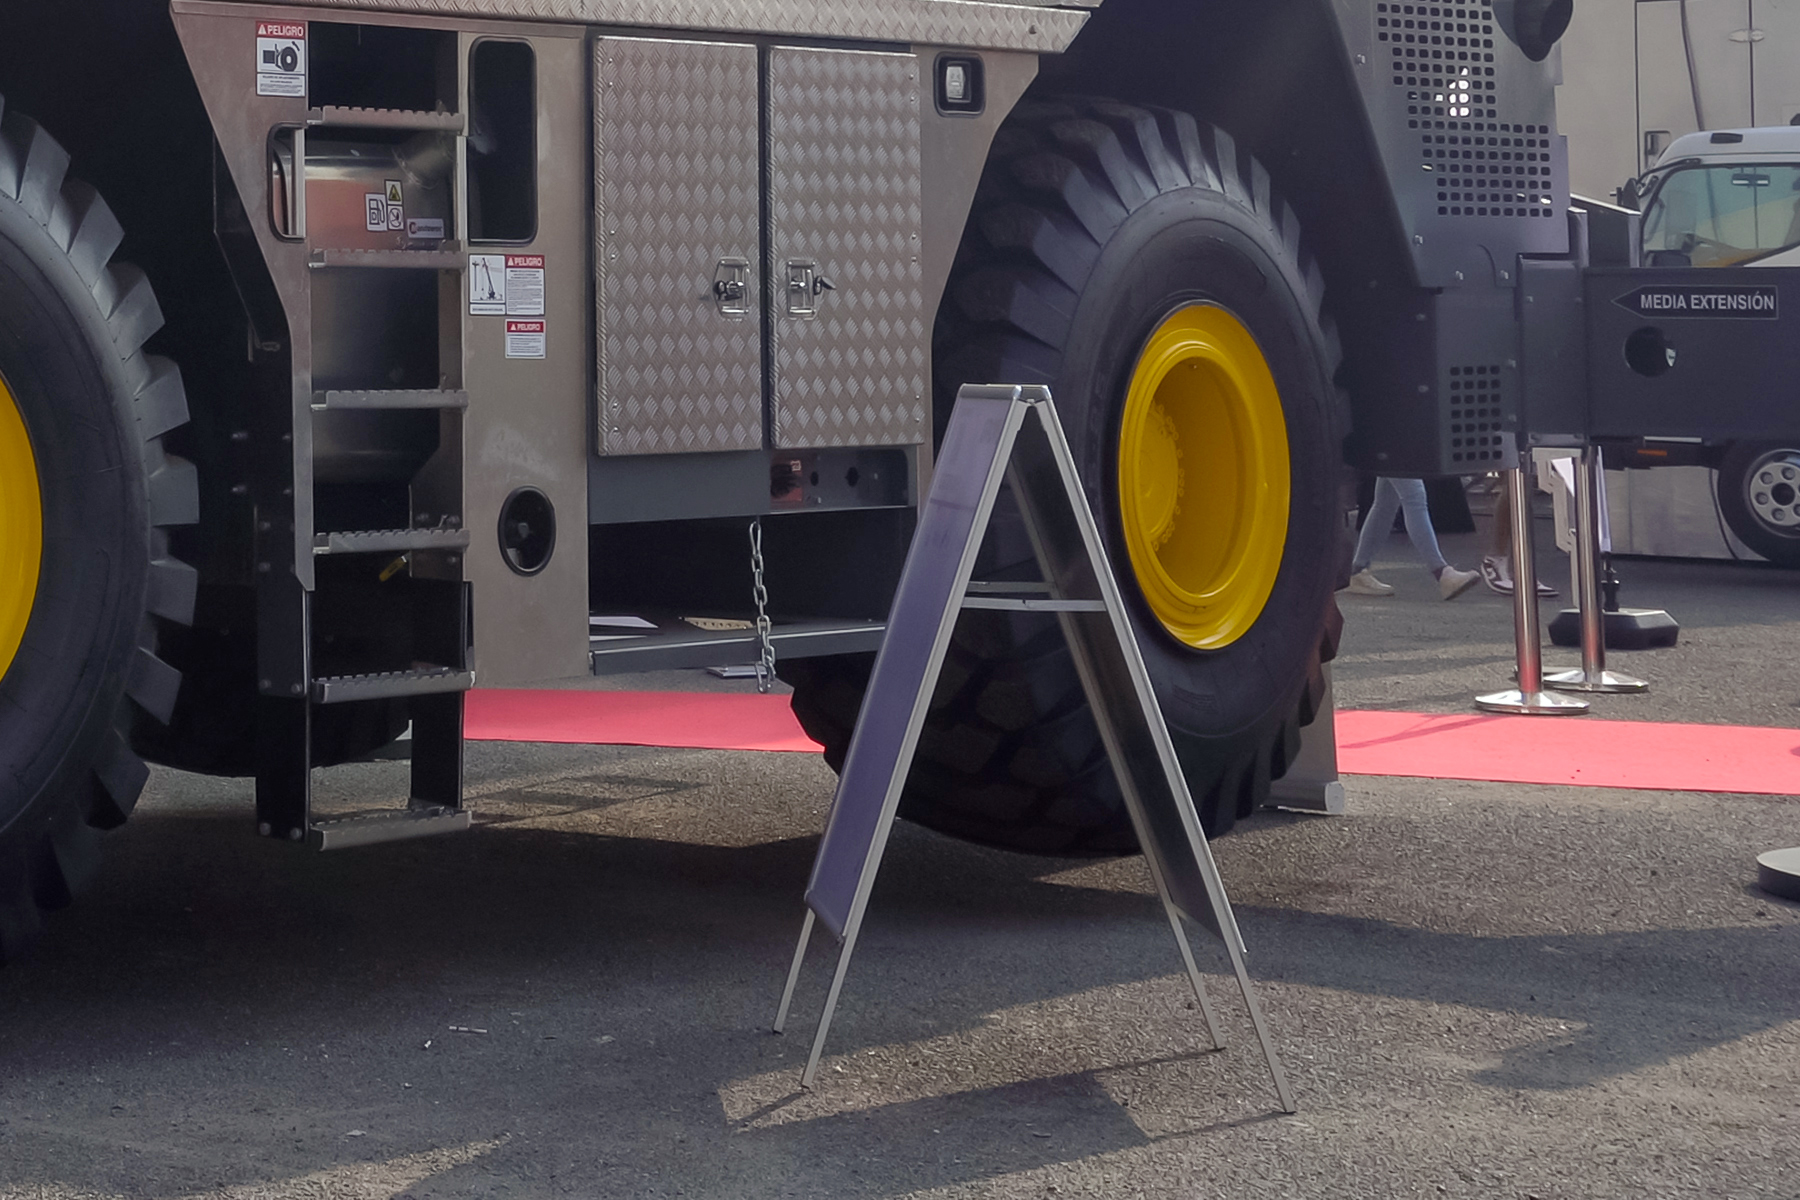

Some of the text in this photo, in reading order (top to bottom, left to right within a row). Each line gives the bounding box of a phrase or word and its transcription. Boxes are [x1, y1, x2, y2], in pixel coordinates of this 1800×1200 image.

[267, 25, 304, 37] PELIGRO
[514, 257, 542, 266] PELIGRO
[1640, 290, 1774, 310] MEDIA EXTENSIÓN
